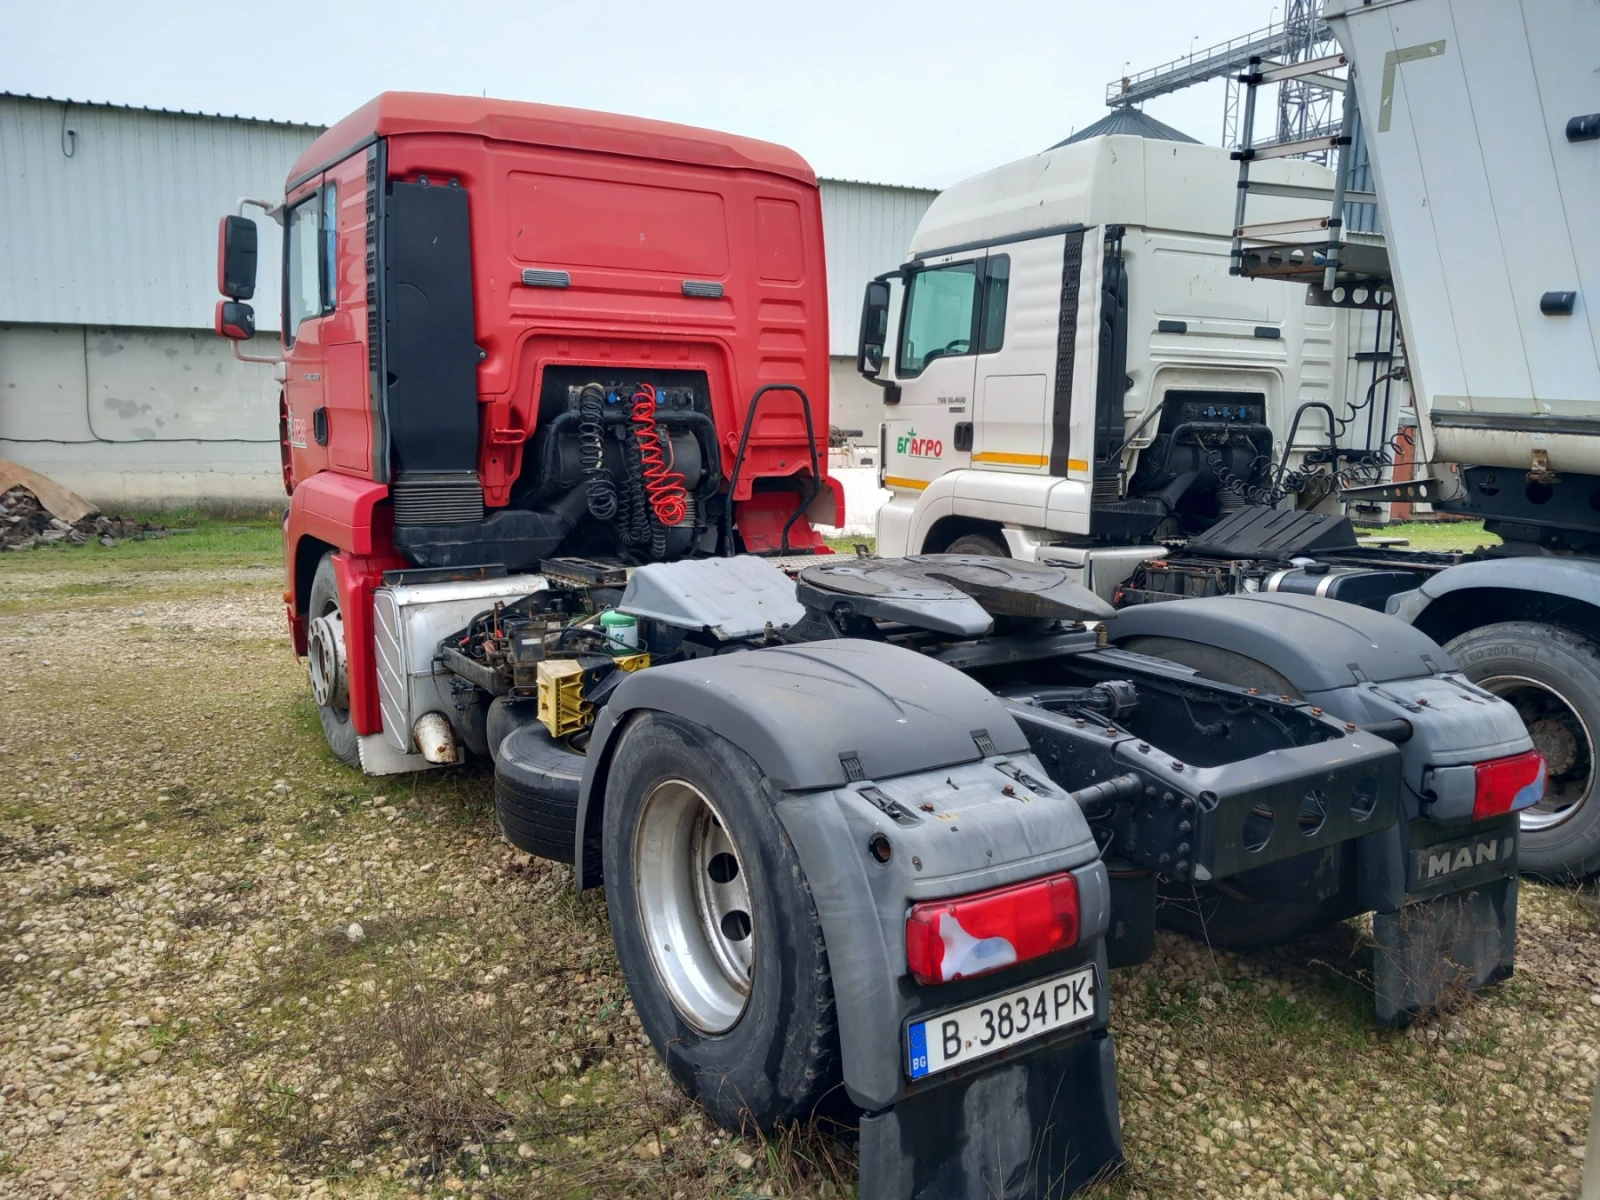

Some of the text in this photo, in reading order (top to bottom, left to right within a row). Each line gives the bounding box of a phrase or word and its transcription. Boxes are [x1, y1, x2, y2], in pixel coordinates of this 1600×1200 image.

[1487, 646, 1508, 656] 200
[1428, 840, 1497, 878] MAN
[912, 1056, 926, 1071] BG
